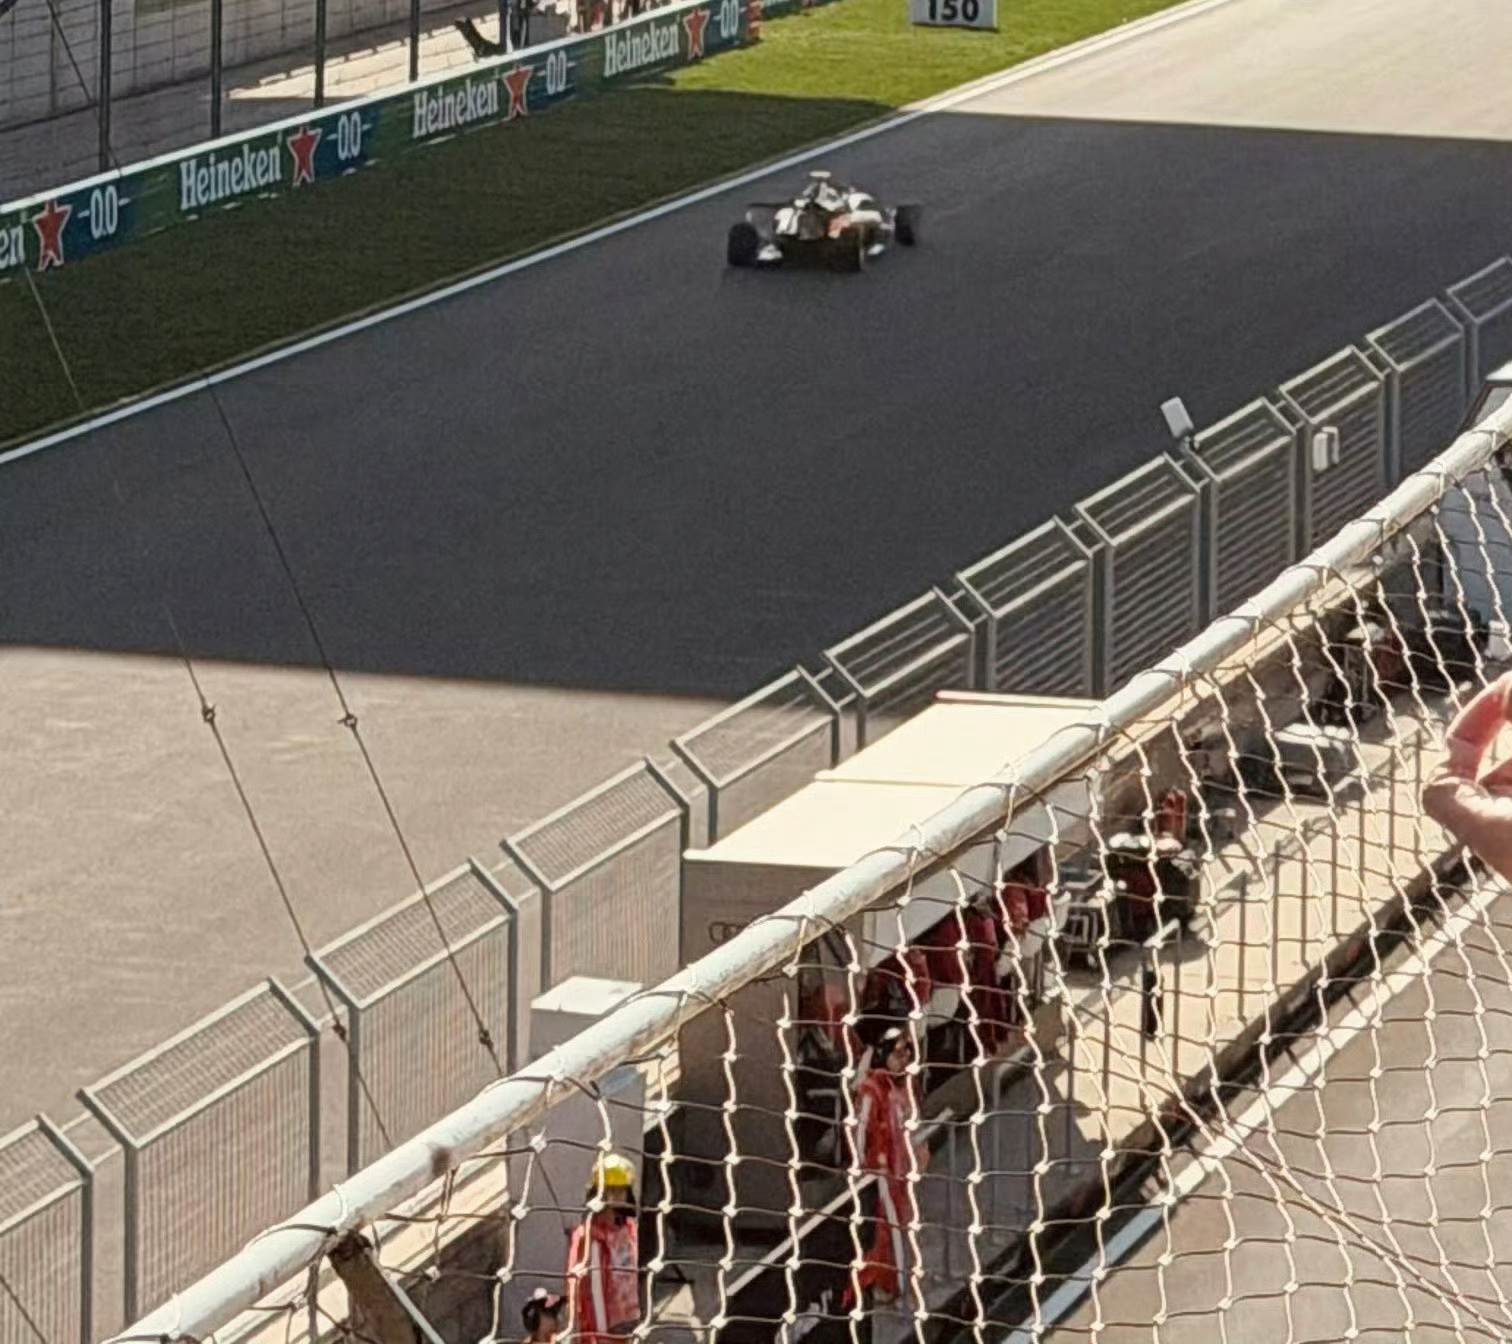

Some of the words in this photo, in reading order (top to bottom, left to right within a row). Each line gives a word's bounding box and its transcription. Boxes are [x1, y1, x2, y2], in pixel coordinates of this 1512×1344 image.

[604, 16, 680, 76] Heineken
[413, 80, 499, 138] Heineken
[181, 142, 282, 210] Heineken
